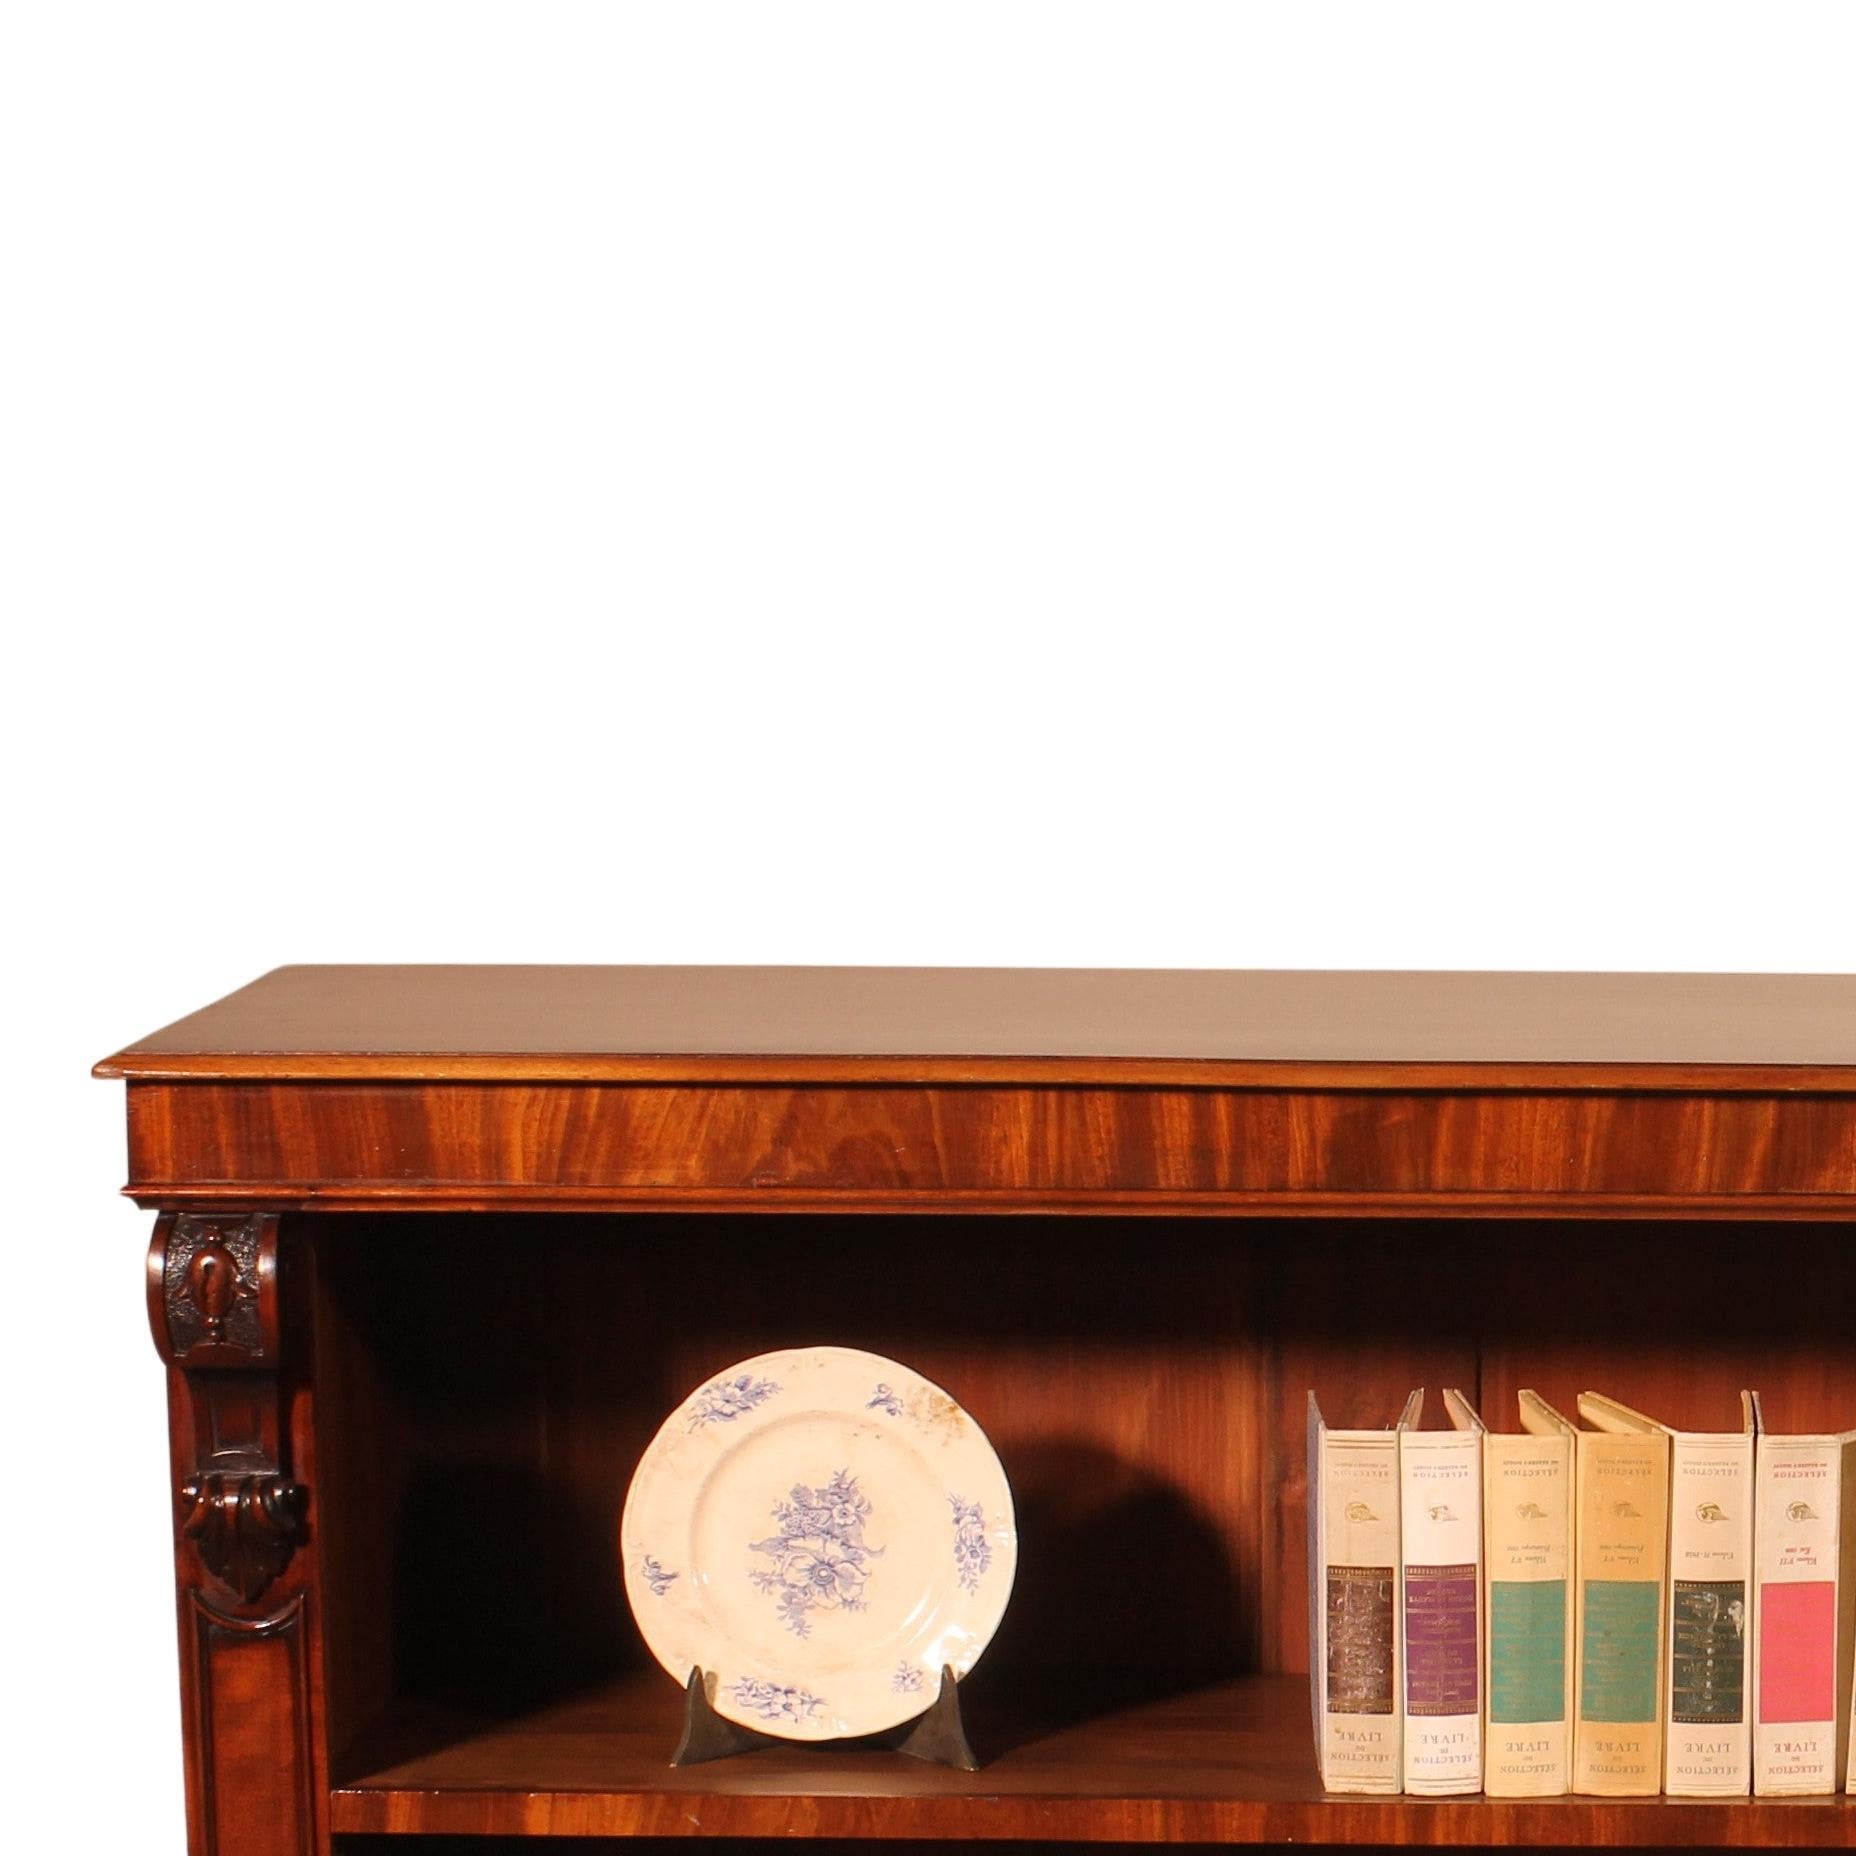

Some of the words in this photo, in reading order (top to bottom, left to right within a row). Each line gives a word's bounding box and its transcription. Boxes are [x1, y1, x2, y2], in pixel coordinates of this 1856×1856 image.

[1336, 1731, 1382, 1742] LIVRE
[1421, 1732, 1465, 1744] LIVRE
[1506, 1741, 1550, 1752] LIVRE
[1595, 1741, 1640, 1752] LIVRE
[1685, 1743, 1730, 1753] LIVRE
[1775, 1741, 1817, 1753] LIVRE
[1414, 1753, 1472, 1764] SÉLECTION
[1500, 1763, 1556, 1774] SÉLECTION
[1676, 1766, 1737, 1776] SÉLECTION
[1769, 1765, 1824, 1775] SÉLECTION
